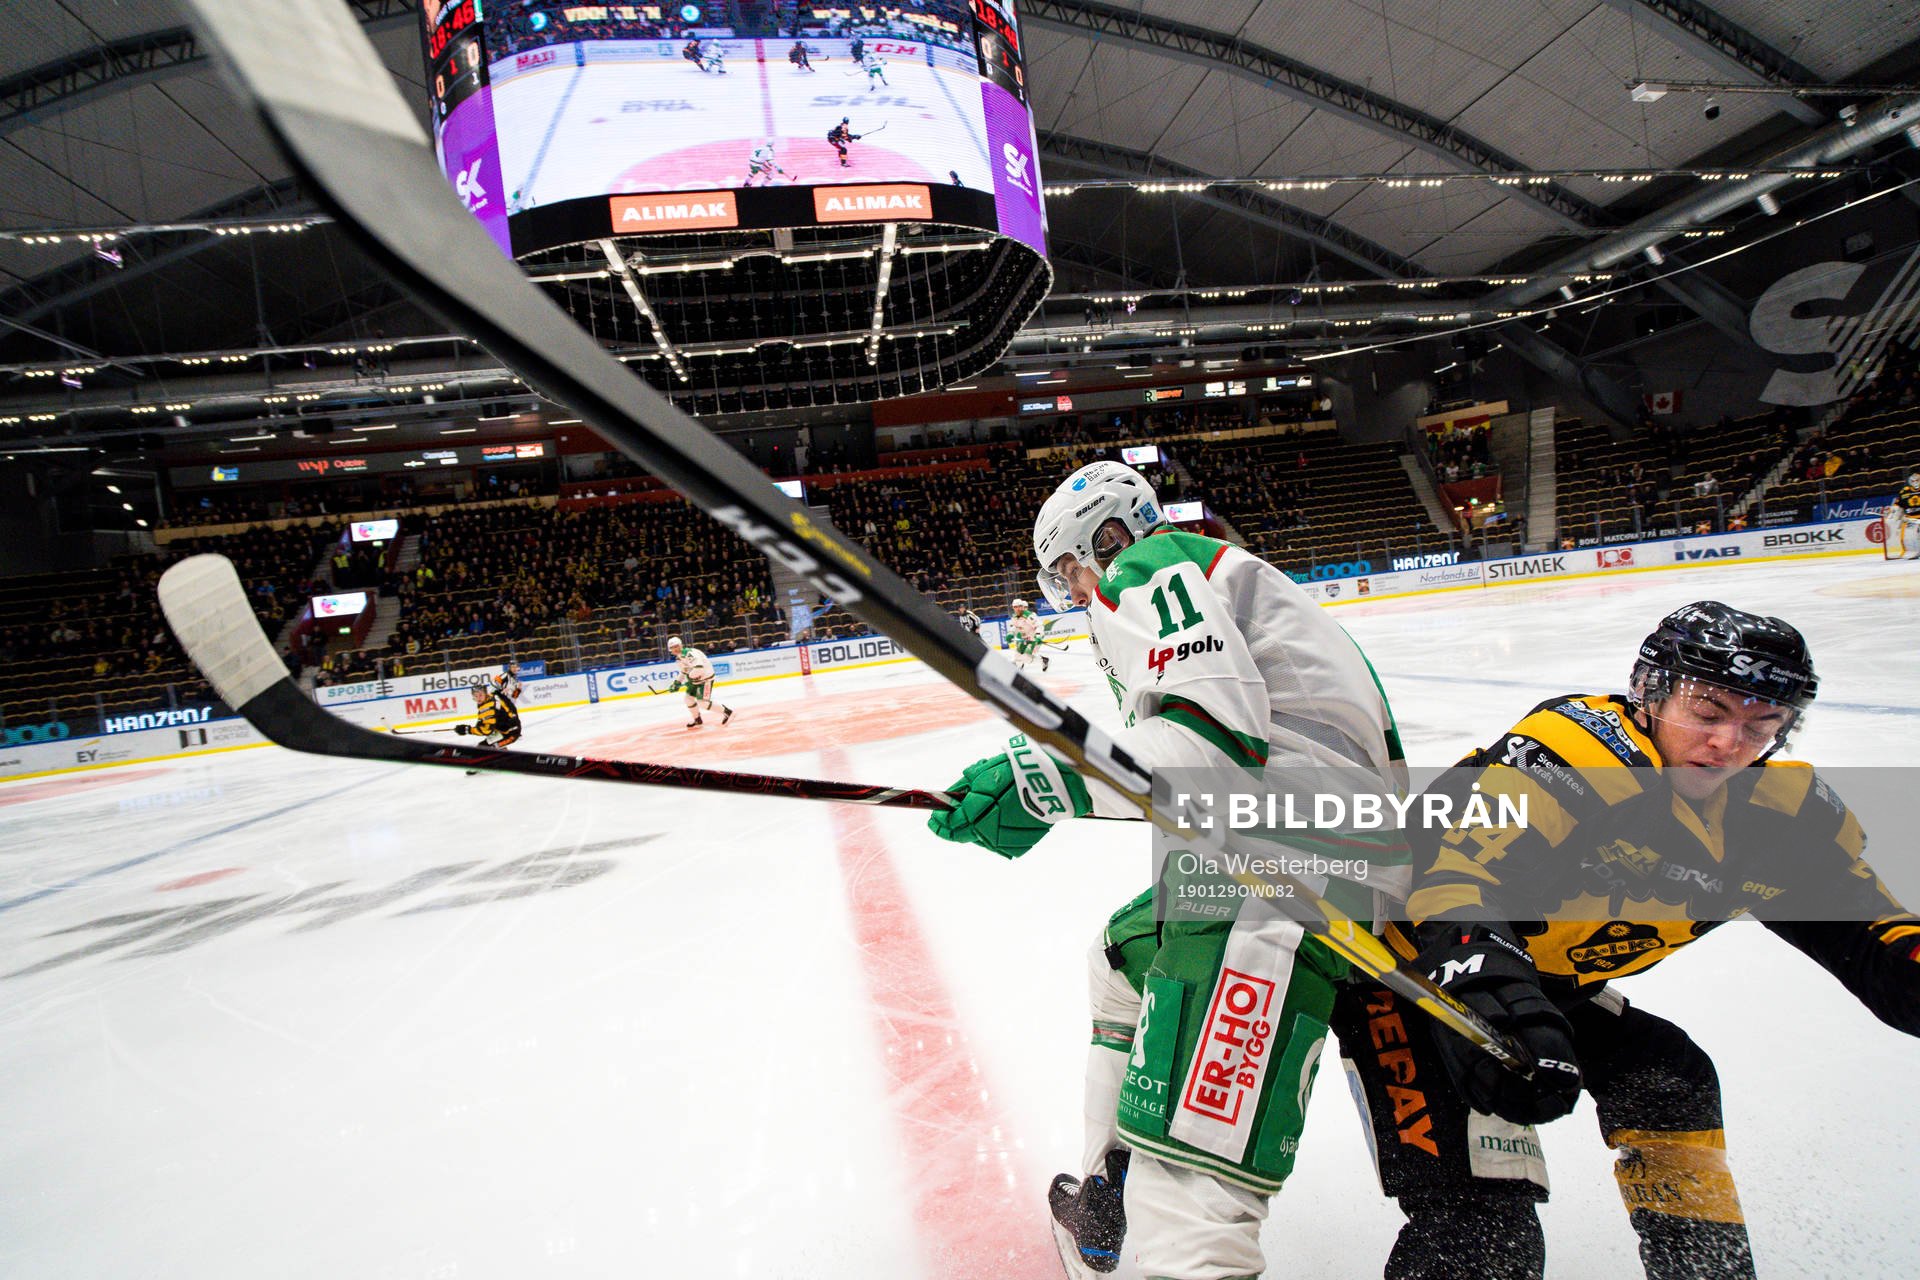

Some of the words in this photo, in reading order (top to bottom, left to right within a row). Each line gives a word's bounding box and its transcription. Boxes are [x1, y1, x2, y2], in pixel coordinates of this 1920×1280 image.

[621, 202, 728, 222] ALIMAK
[824, 194, 924, 213] ALIMAK
[1075, 495, 1106, 519] BAUER
[1763, 528, 1845, 547] BROKK
[1466, 567, 1481, 578] Bil
[1150, 572, 1205, 640] 11
[818, 639, 904, 664] BOLIDEN
[1176, 635, 1224, 662] golv
[422, 672, 491, 691] Henson
[627, 669, 683, 684] exten
[327, 683, 375, 698] SPORT
[76, 749, 99, 763] EY
[1008, 732, 1067, 816] AUER
[1529, 762, 1554, 784] Kraft
[1175, 900, 1232, 917] AUER
[1194, 981, 1259, 1112] ER-HO
[1235, 1020, 1272, 1090] BYGG
